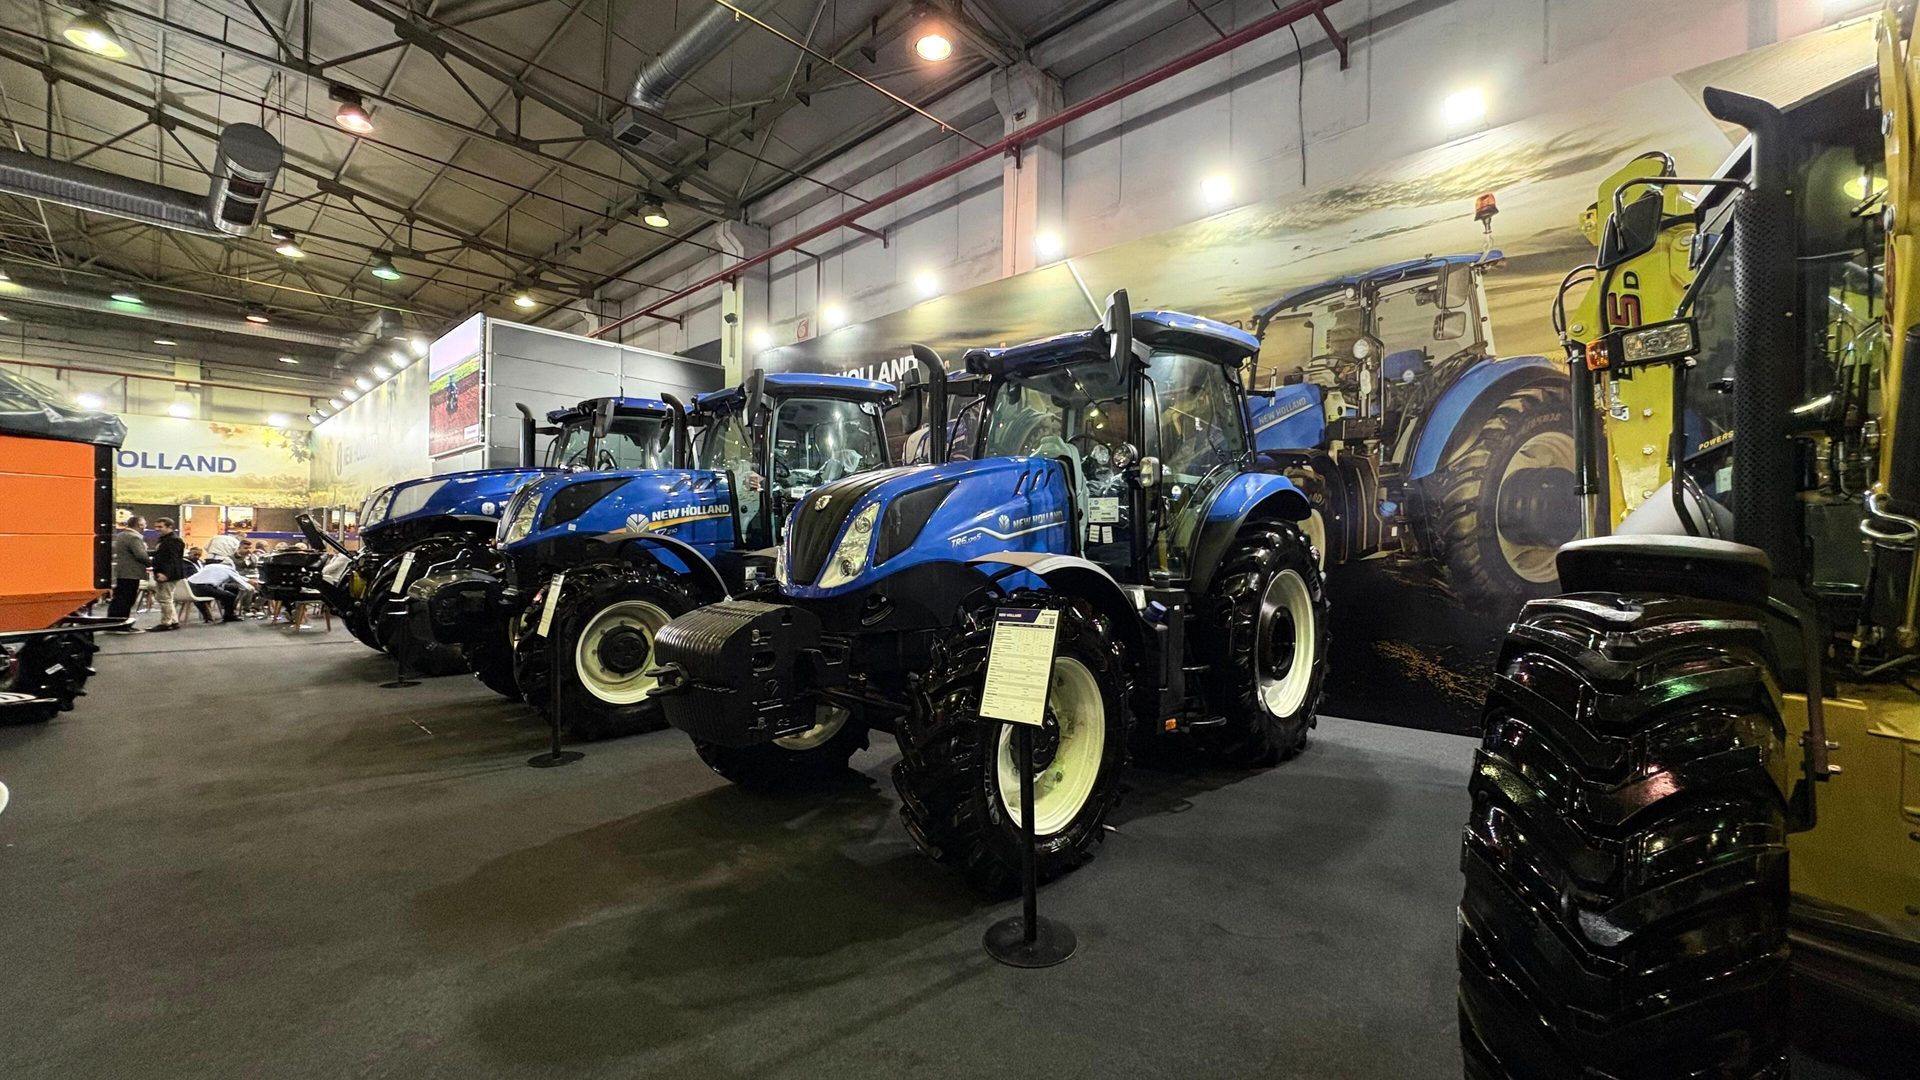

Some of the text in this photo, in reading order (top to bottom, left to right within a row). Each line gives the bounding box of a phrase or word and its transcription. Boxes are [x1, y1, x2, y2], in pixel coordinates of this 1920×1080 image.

[1259, 397, 1306, 424] NEW HOLLAND
[652, 504, 730, 521] NEW HOLLAND
[1013, 511, 1063, 528] NEW HOLLAND
